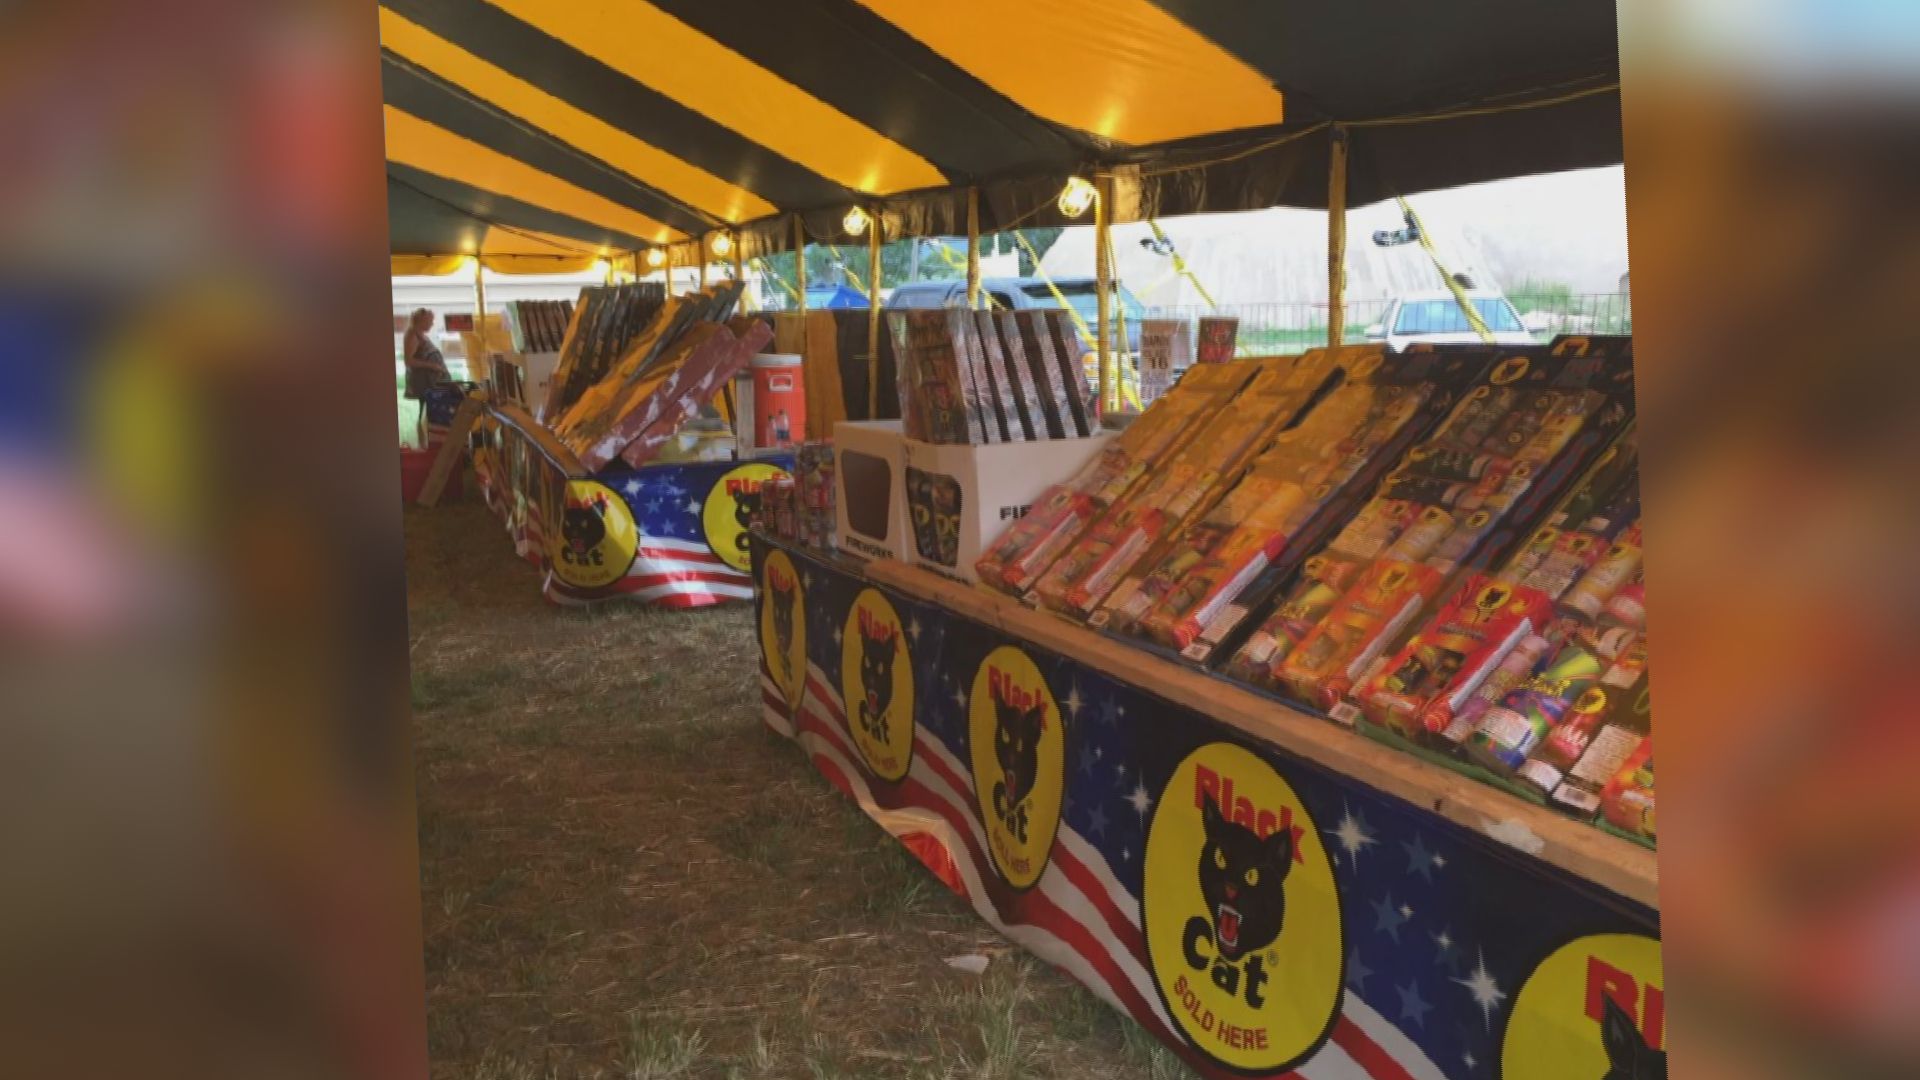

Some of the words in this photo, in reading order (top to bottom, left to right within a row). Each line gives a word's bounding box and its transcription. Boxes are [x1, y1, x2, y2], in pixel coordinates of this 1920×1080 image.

[857, 604, 901, 654] Black
[860, 698, 891, 747] Cat
[988, 664, 1049, 731] Black
[992, 780, 1029, 845] Cat
[1194, 762, 1306, 865] Black
[1182, 914, 1269, 1011] Cat
[1173, 973, 1214, 1034] SOLD
[1216, 1019, 1270, 1053] HERE
